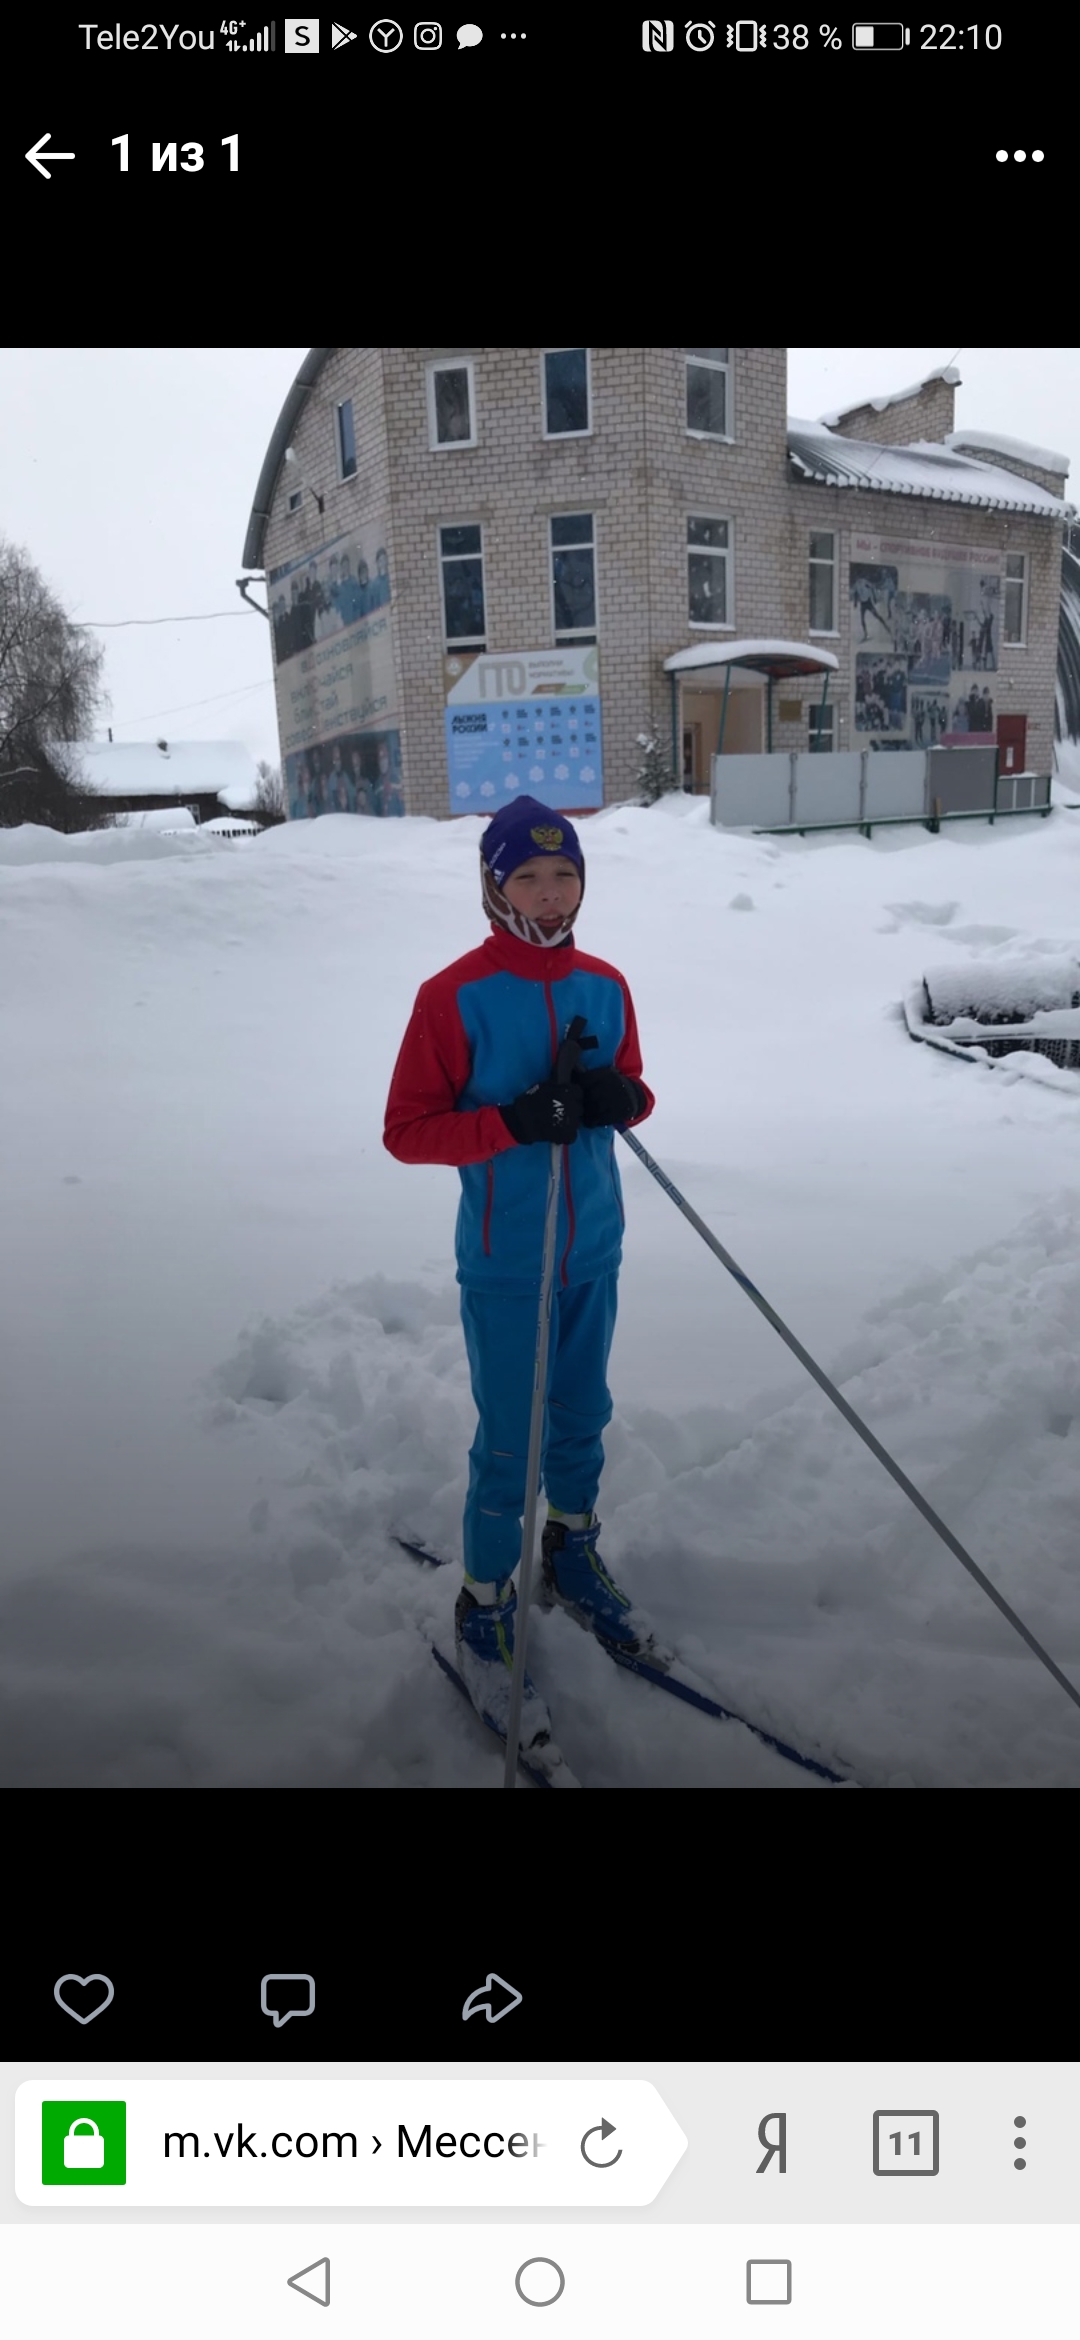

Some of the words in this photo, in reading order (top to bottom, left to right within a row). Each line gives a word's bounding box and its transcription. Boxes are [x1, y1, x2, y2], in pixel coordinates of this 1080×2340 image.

[79, 23, 214, 50] Tele2You
[773, 24, 808, 50] 38
[820, 24, 842, 50] %
[920, 24, 1001, 50] 22:10
[112, 134, 128, 172] 1
[153, 142, 204, 173] из
[222, 134, 238, 172] 1
[451, 713, 487, 725] ЛЫЖНЯ
[452, 723, 488, 735] РОССИИ
[164, 2122, 357, 2158] m.vk.com
[890, 2132, 919, 2155] 11
